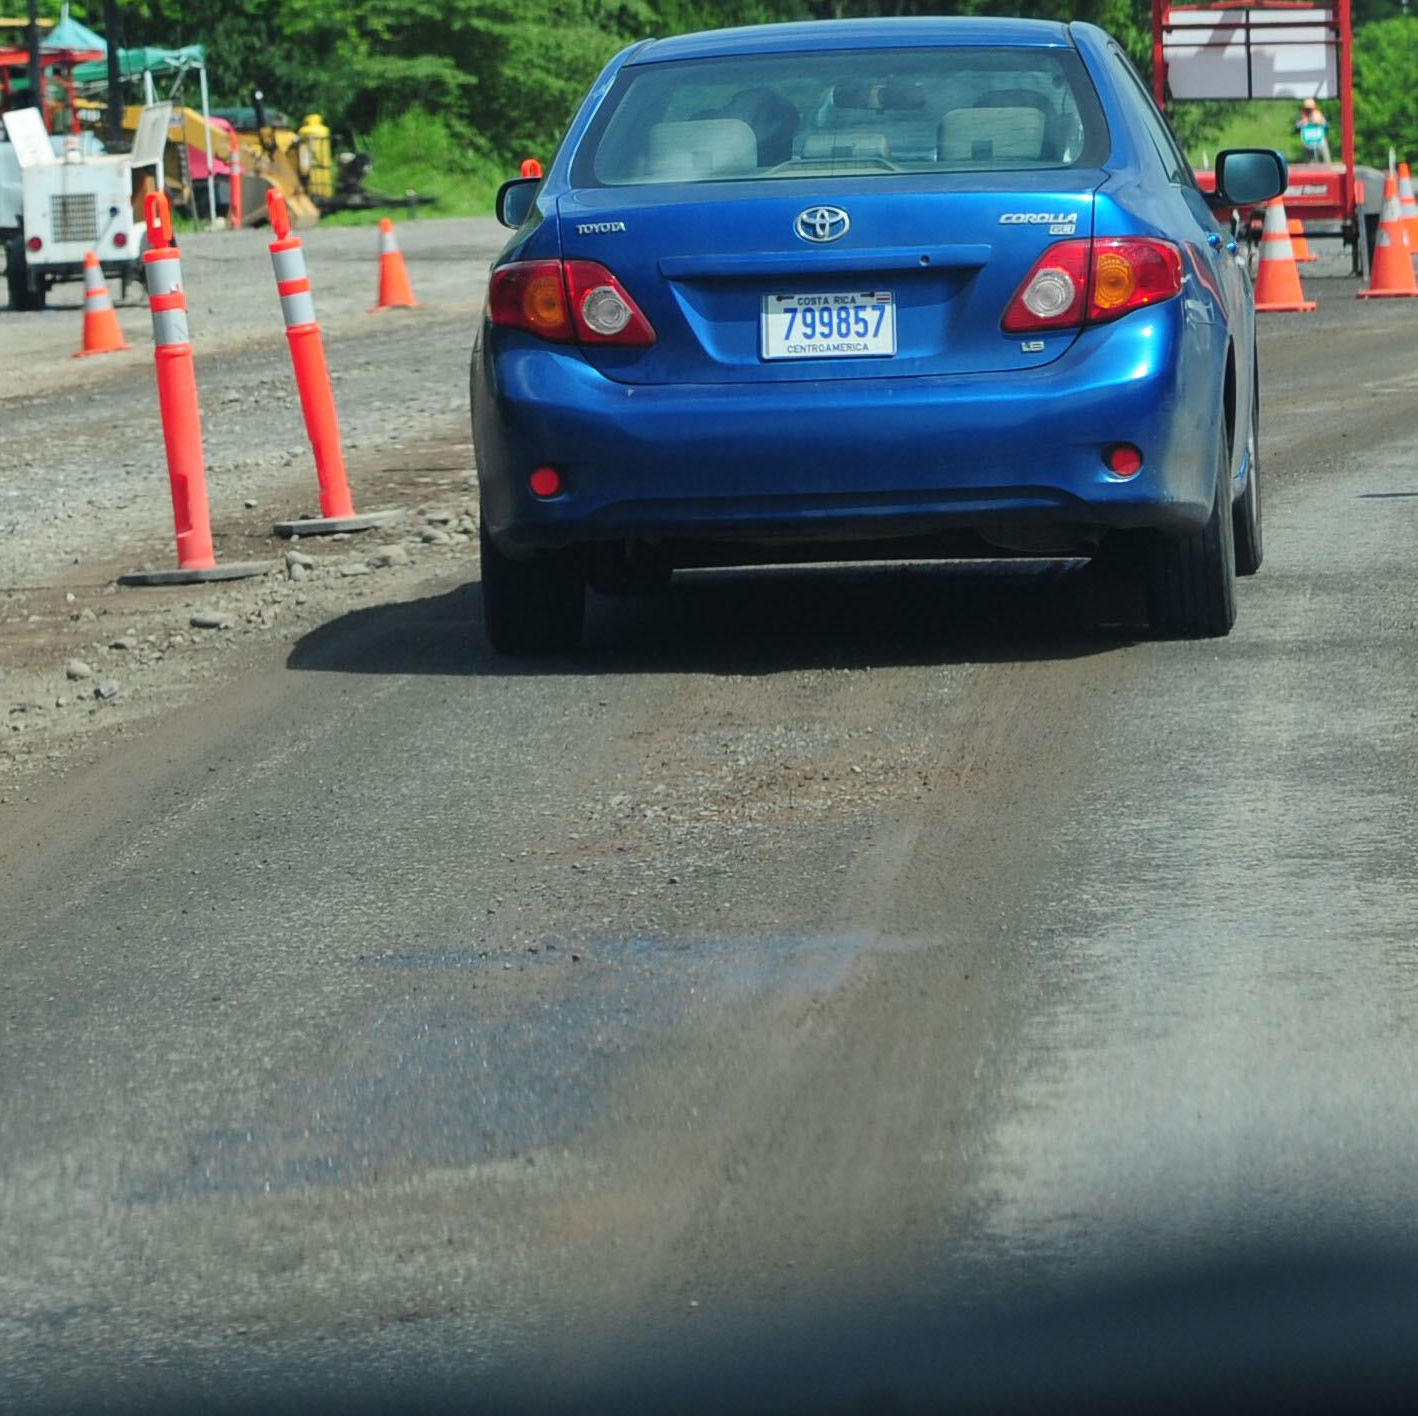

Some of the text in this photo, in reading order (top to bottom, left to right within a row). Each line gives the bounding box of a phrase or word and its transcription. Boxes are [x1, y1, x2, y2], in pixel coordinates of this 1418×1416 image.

[999, 213, 1078, 224] COROLLA
[575, 222, 626, 234] TOYOTA
[797, 295, 857, 306] COSTA RICA
[783, 304, 887, 340] 799857
[787, 342, 869, 354] CENTROAMERICA
